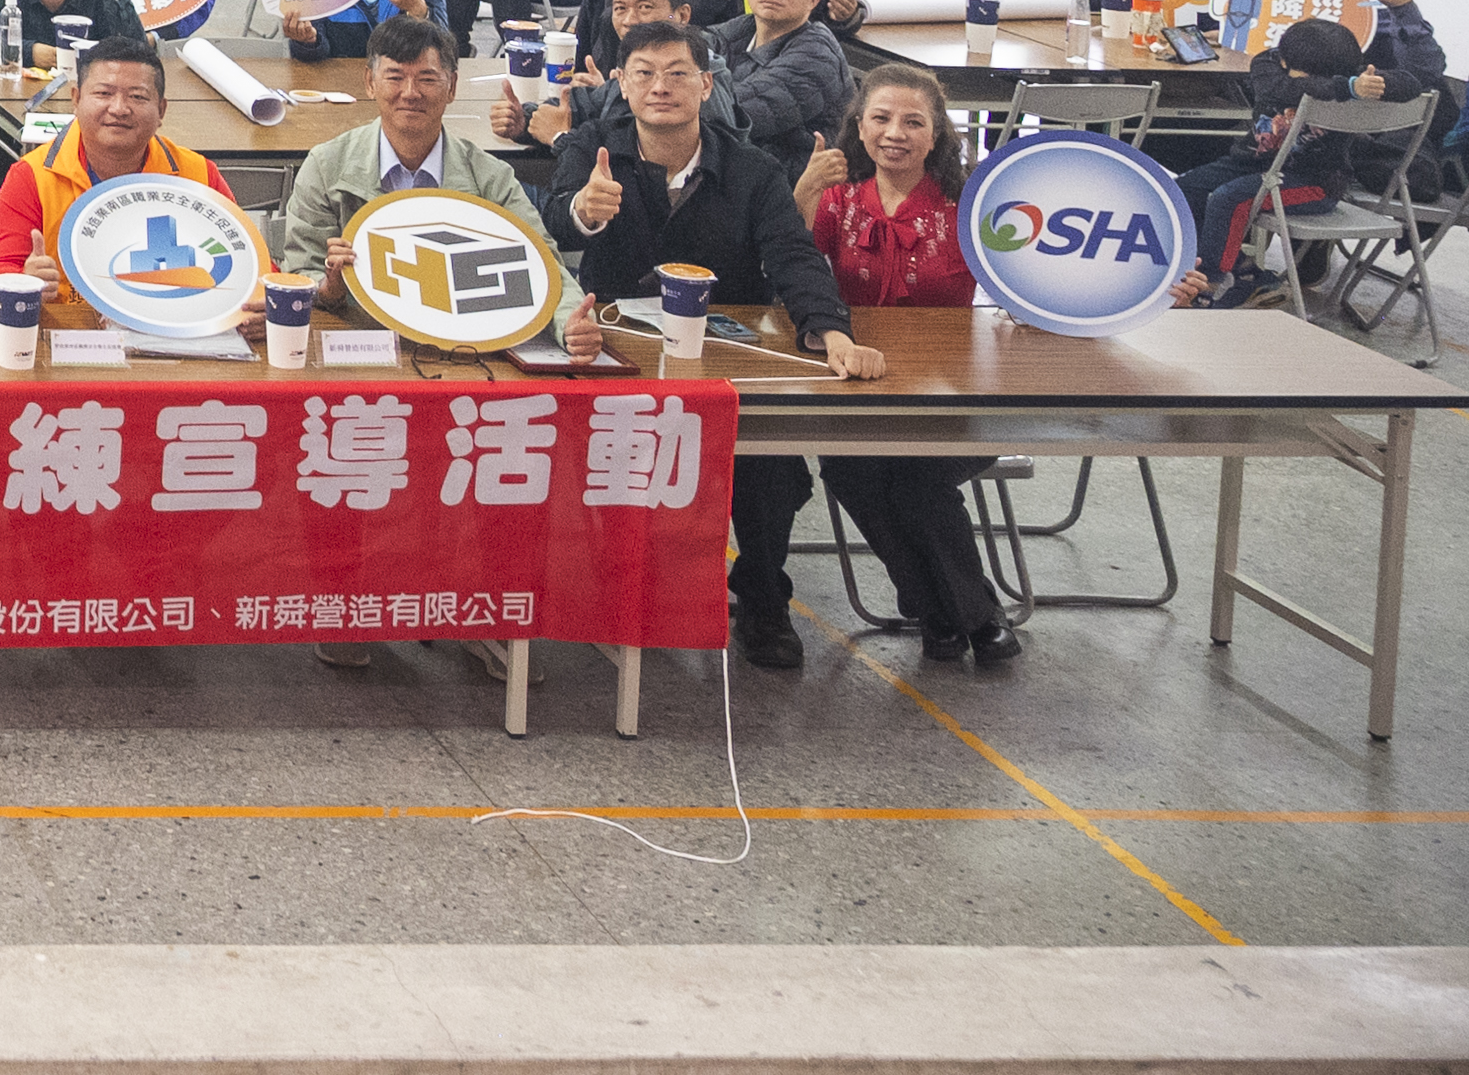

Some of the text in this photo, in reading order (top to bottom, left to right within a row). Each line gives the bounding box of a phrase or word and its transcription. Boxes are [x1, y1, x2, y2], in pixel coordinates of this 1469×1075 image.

[81, 190, 247, 252] 營造業南區職業安全衛生促進會
[980, 200, 1169, 266] OSHA
